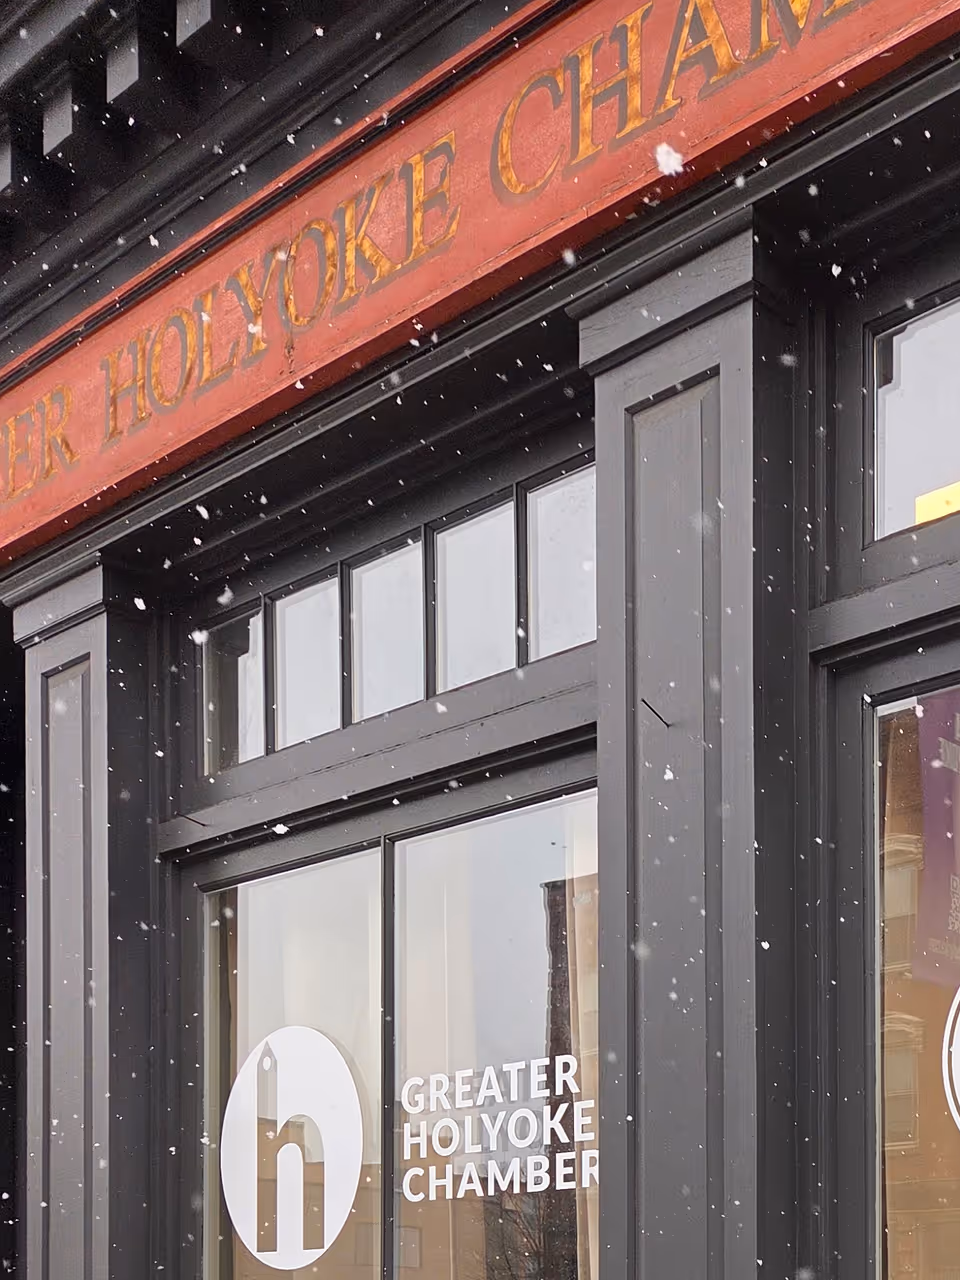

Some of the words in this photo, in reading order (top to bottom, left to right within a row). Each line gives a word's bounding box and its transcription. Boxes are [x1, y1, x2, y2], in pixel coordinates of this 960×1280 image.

[102, 131, 460, 443] HOLYOKE
[401, 1054, 581, 1114] GREATER
[403, 1100, 595, 1160] HOLYOKE
[402, 1149, 599, 1202] CHAMBER
